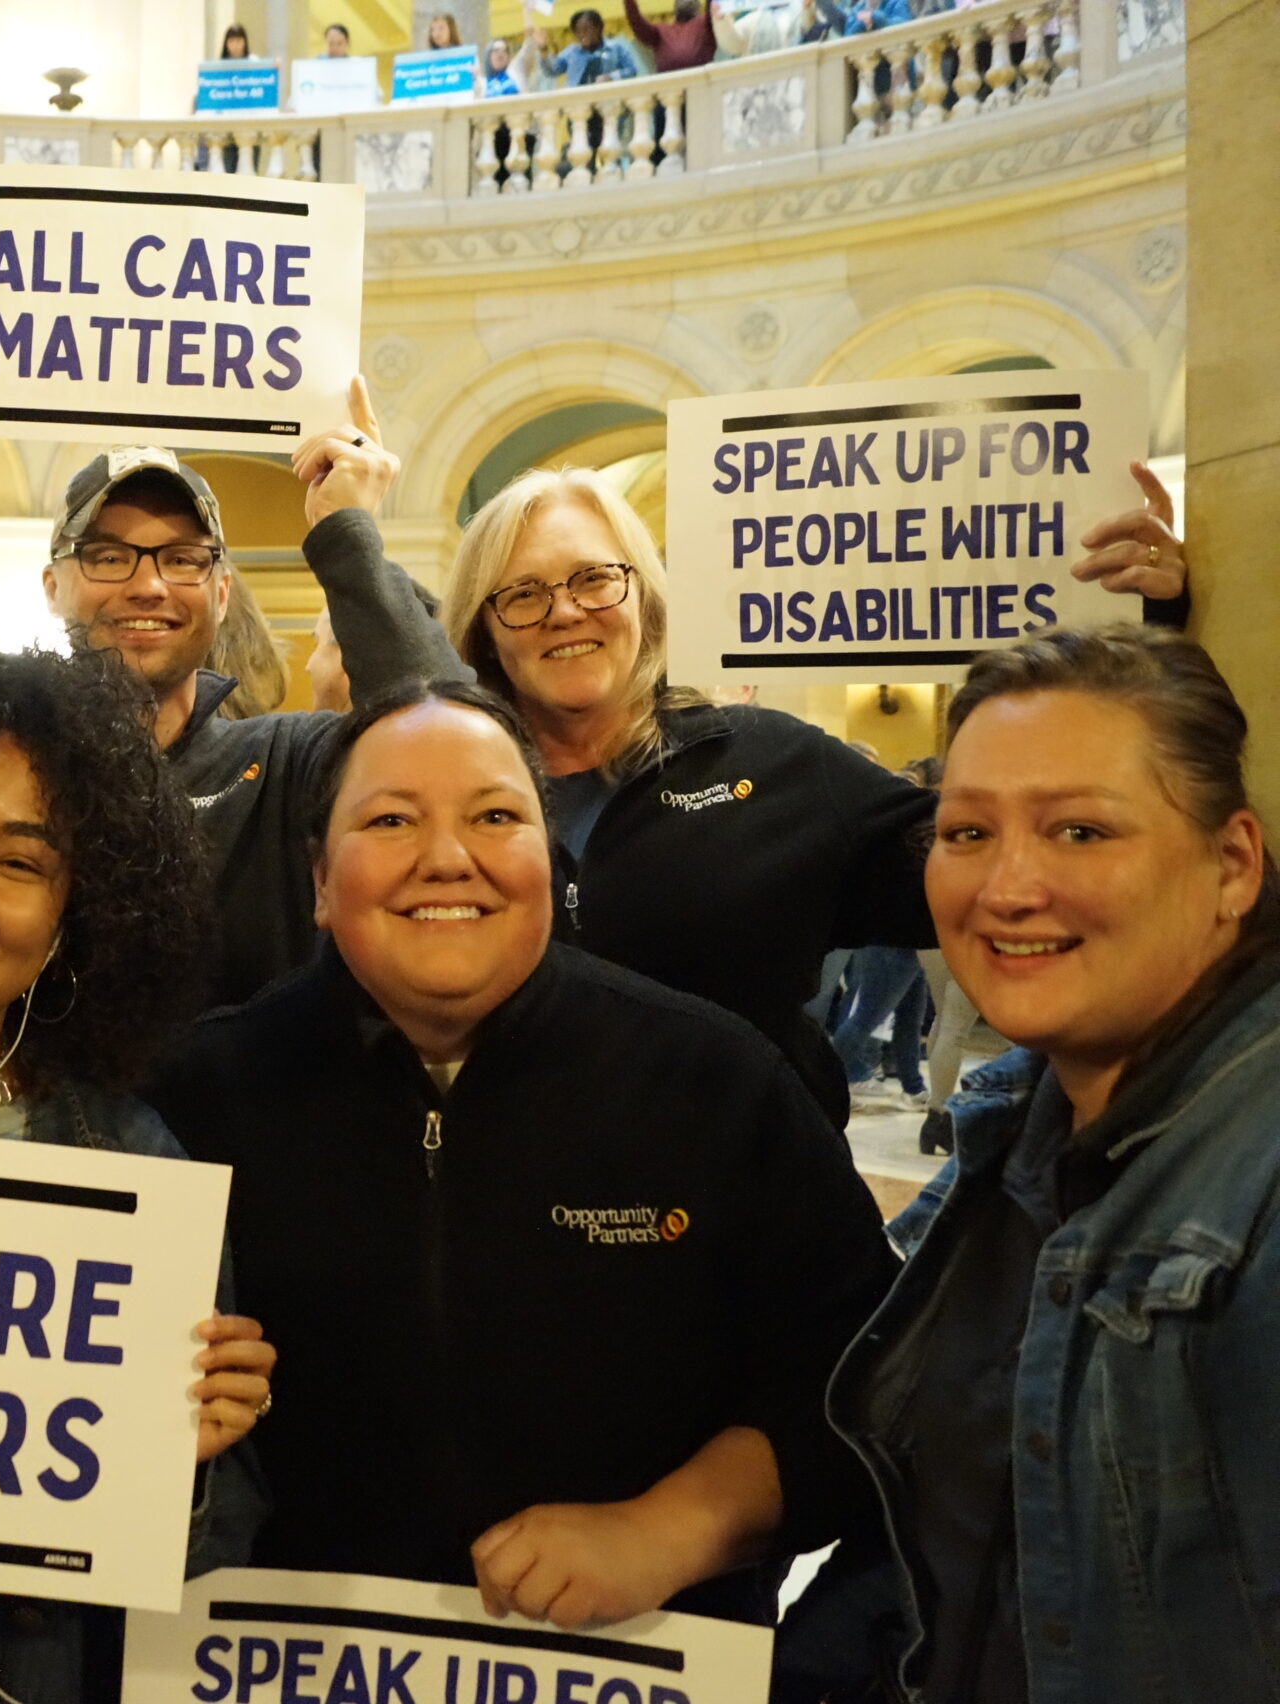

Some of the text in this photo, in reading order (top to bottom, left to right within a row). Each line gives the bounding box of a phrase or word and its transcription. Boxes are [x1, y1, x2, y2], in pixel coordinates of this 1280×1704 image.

[124, 235, 311, 306] CARE
[712, 421, 1090, 494] SPEAK UP FOR
[733, 501, 1063, 569] PEOPLE WITH
[739, 583, 1058, 643] DISABILITIES
[661, 782, 730, 808] Opportunity
[684, 792, 734, 812] Partners
[551, 1204, 659, 1229] Opportunity
[587, 1224, 660, 1244] Partners
[191, 1635, 422, 1704] SPEAK
